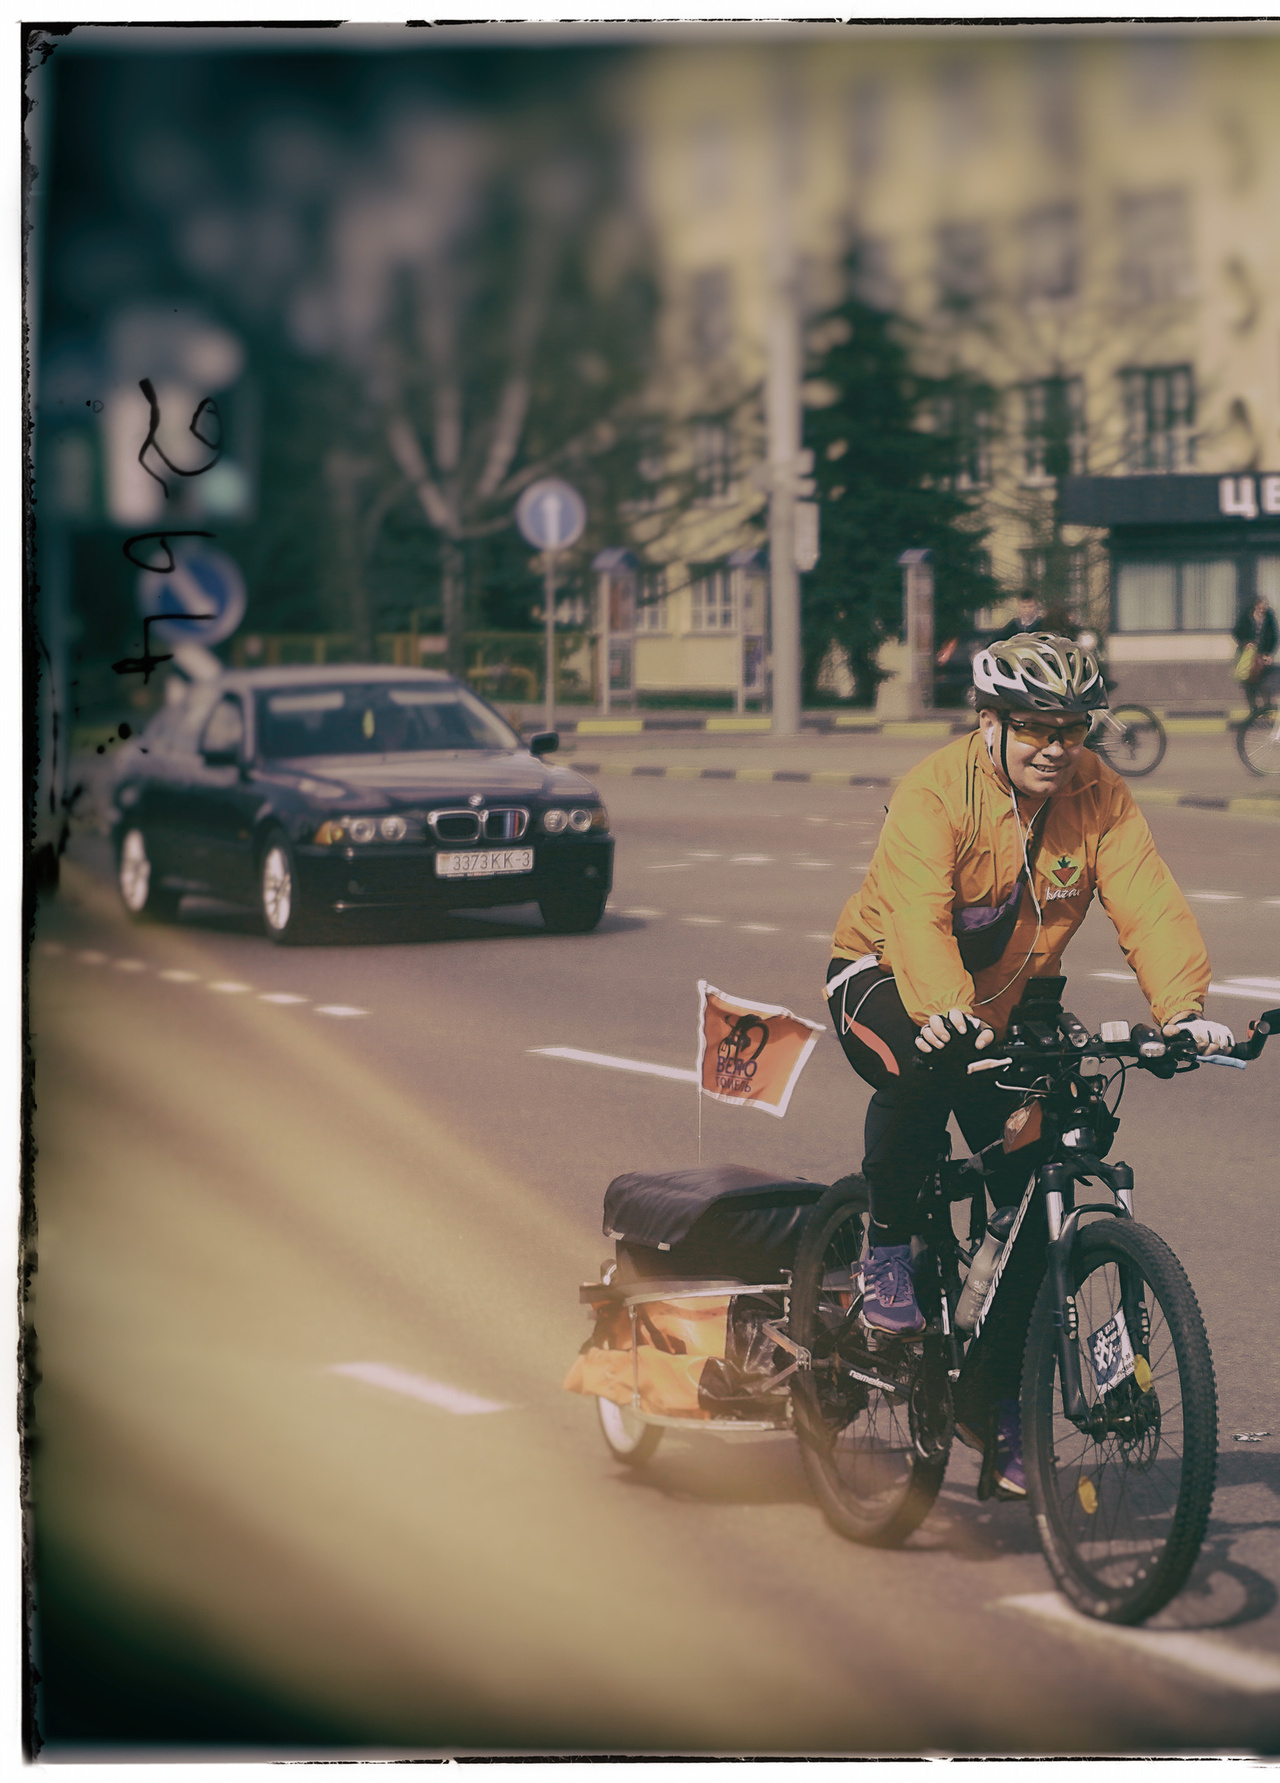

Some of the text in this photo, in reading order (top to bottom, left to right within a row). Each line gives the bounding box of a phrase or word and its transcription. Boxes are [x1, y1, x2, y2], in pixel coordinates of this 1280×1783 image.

[716, 1055, 758, 1078] ВЕЛО
[715, 1076, 752, 1093] ГОМЕЛЬ
[849, 1369, 896, 1393] nameless
